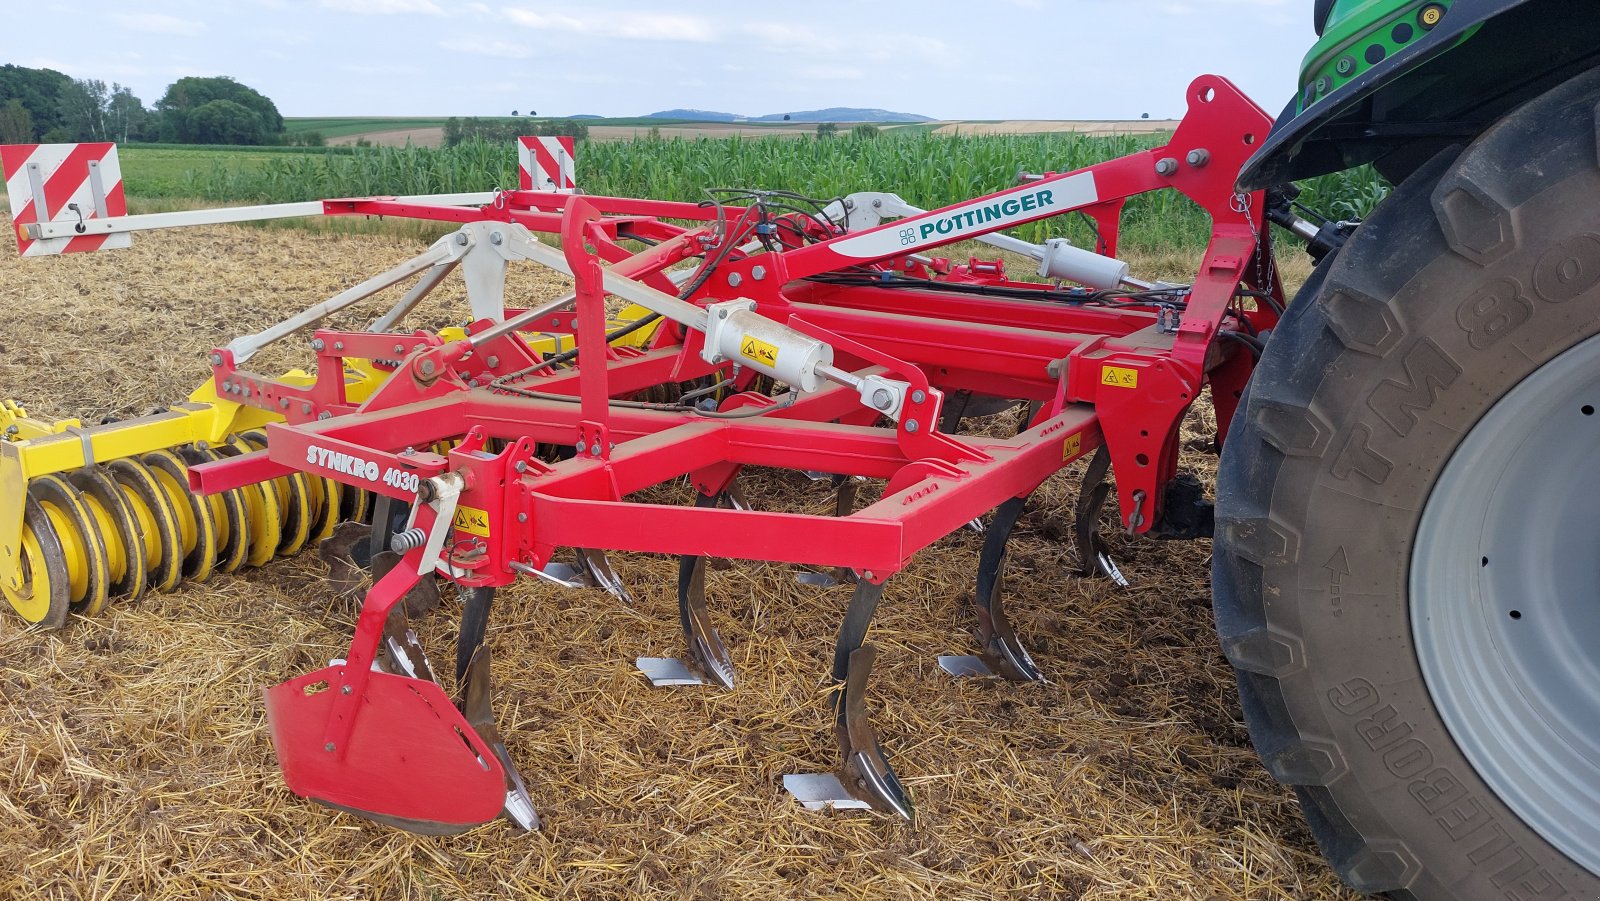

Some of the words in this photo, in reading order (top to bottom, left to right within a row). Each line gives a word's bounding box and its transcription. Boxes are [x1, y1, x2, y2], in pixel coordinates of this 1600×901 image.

[1330, 336, 1464, 485] TM
[306, 445, 380, 482] SYNKRO
[383, 467, 420, 493] 4030
